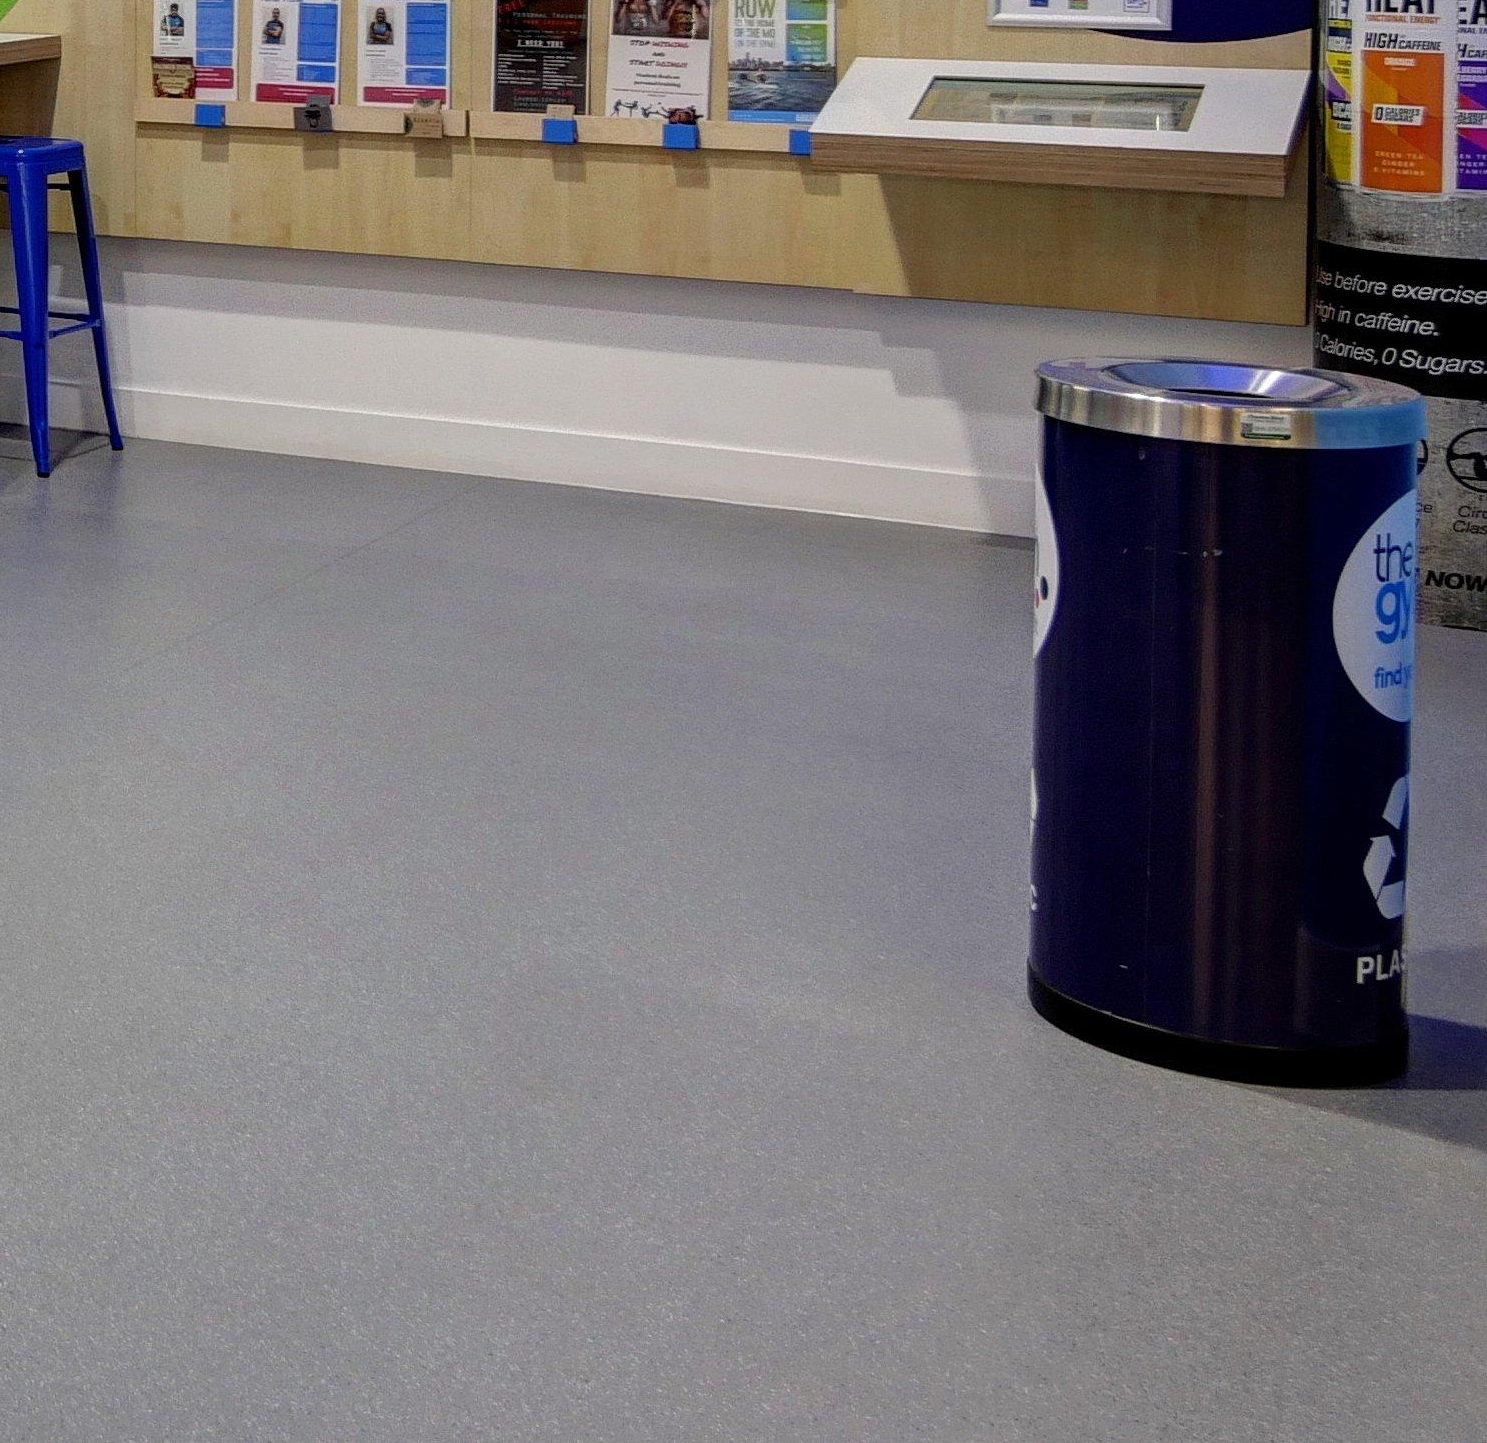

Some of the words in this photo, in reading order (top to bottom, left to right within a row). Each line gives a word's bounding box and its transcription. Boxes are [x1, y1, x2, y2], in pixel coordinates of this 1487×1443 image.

[1365, 32, 1398, 49] HIGH
[1399, 40, 1441, 51] CAFFEINE
[1334, 271, 1388, 296] before
[1392, 284, 1487, 305] exercise
[1338, 305, 1351, 324] in
[1355, 312, 1441, 336] caffeine.
[1320, 334, 1379, 366] Calories,
[1382, 347, 1398, 365] 0
[1373, 533, 1413, 582] the
[1374, 663, 1402, 689] find
